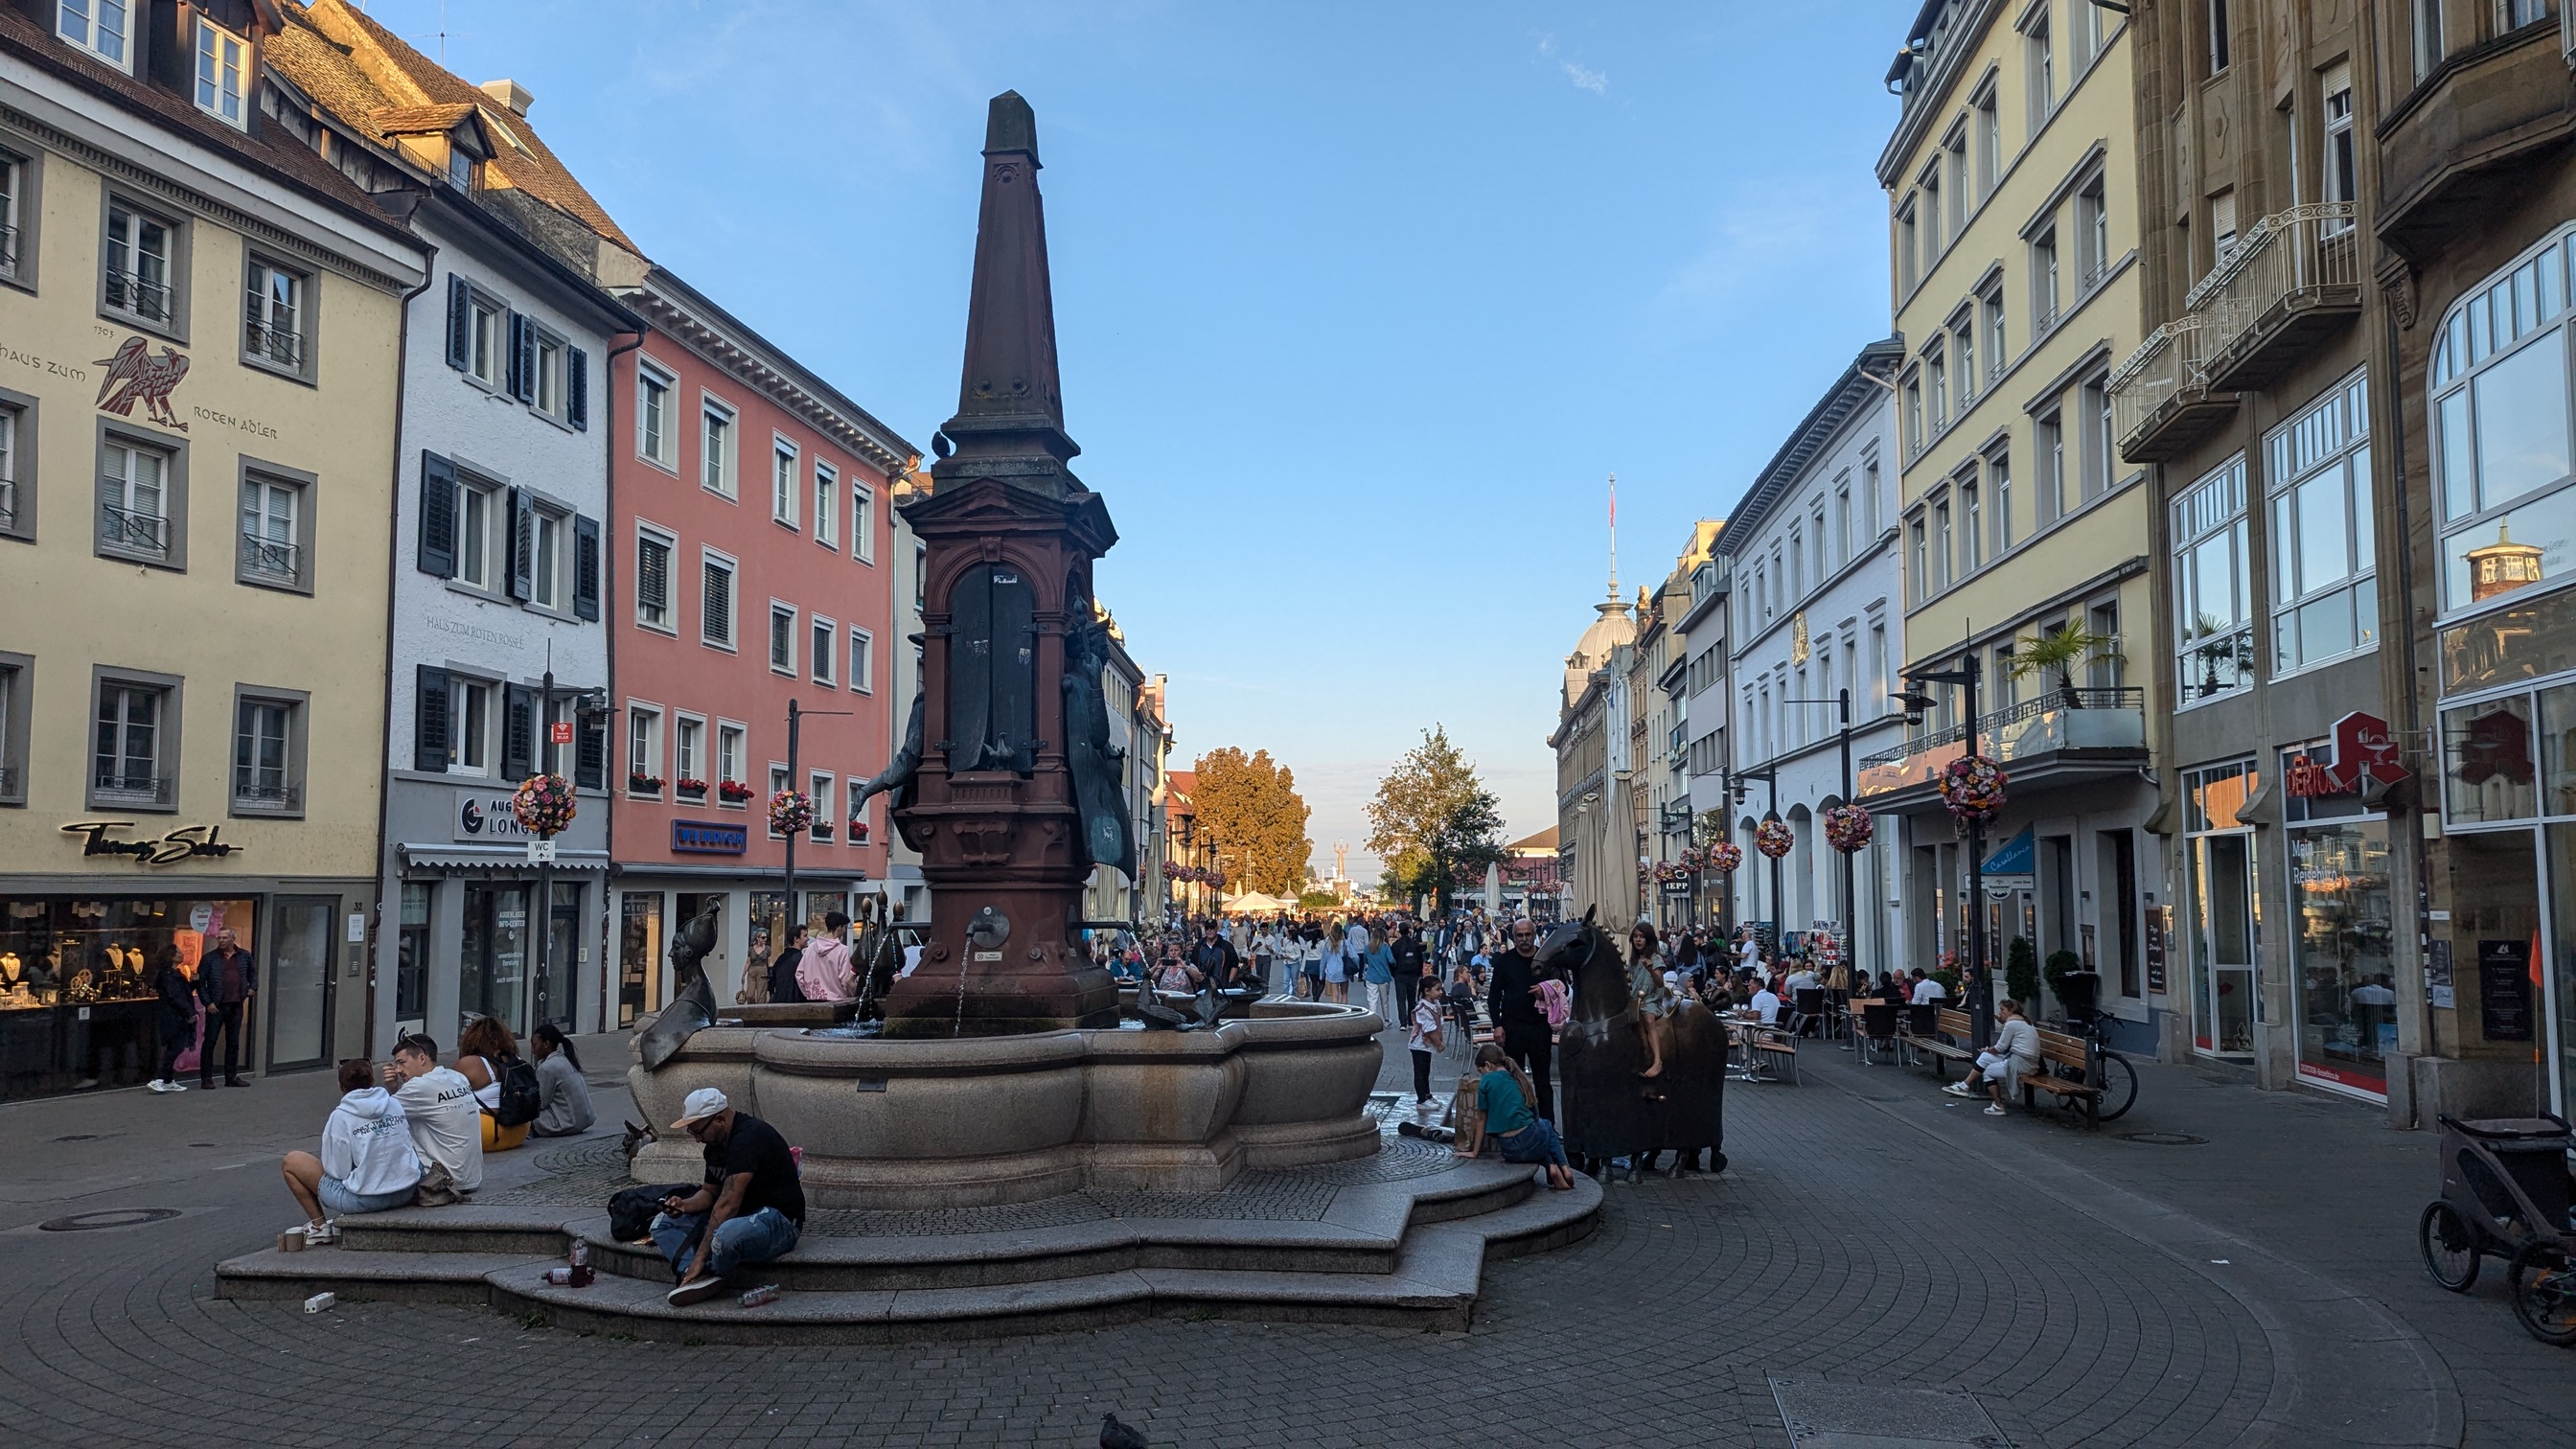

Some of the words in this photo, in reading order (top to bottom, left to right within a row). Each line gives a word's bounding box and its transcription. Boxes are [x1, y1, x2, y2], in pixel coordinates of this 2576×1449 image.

[47, 360, 86, 382] ZUM
[194, 406, 236, 427] ROTEN
[449, 621, 470, 636] ZUM
[471, 627, 497, 644] ROTEN
[535, 842, 549, 851] WC
[2292, 840, 2313, 857] Mein
[1990, 844, 2031, 871] Casablanca
[2293, 866, 2337, 885] Reisebüro
[354, 902, 363, 911] 32
[353, 1123, 370, 1136] ONLY
